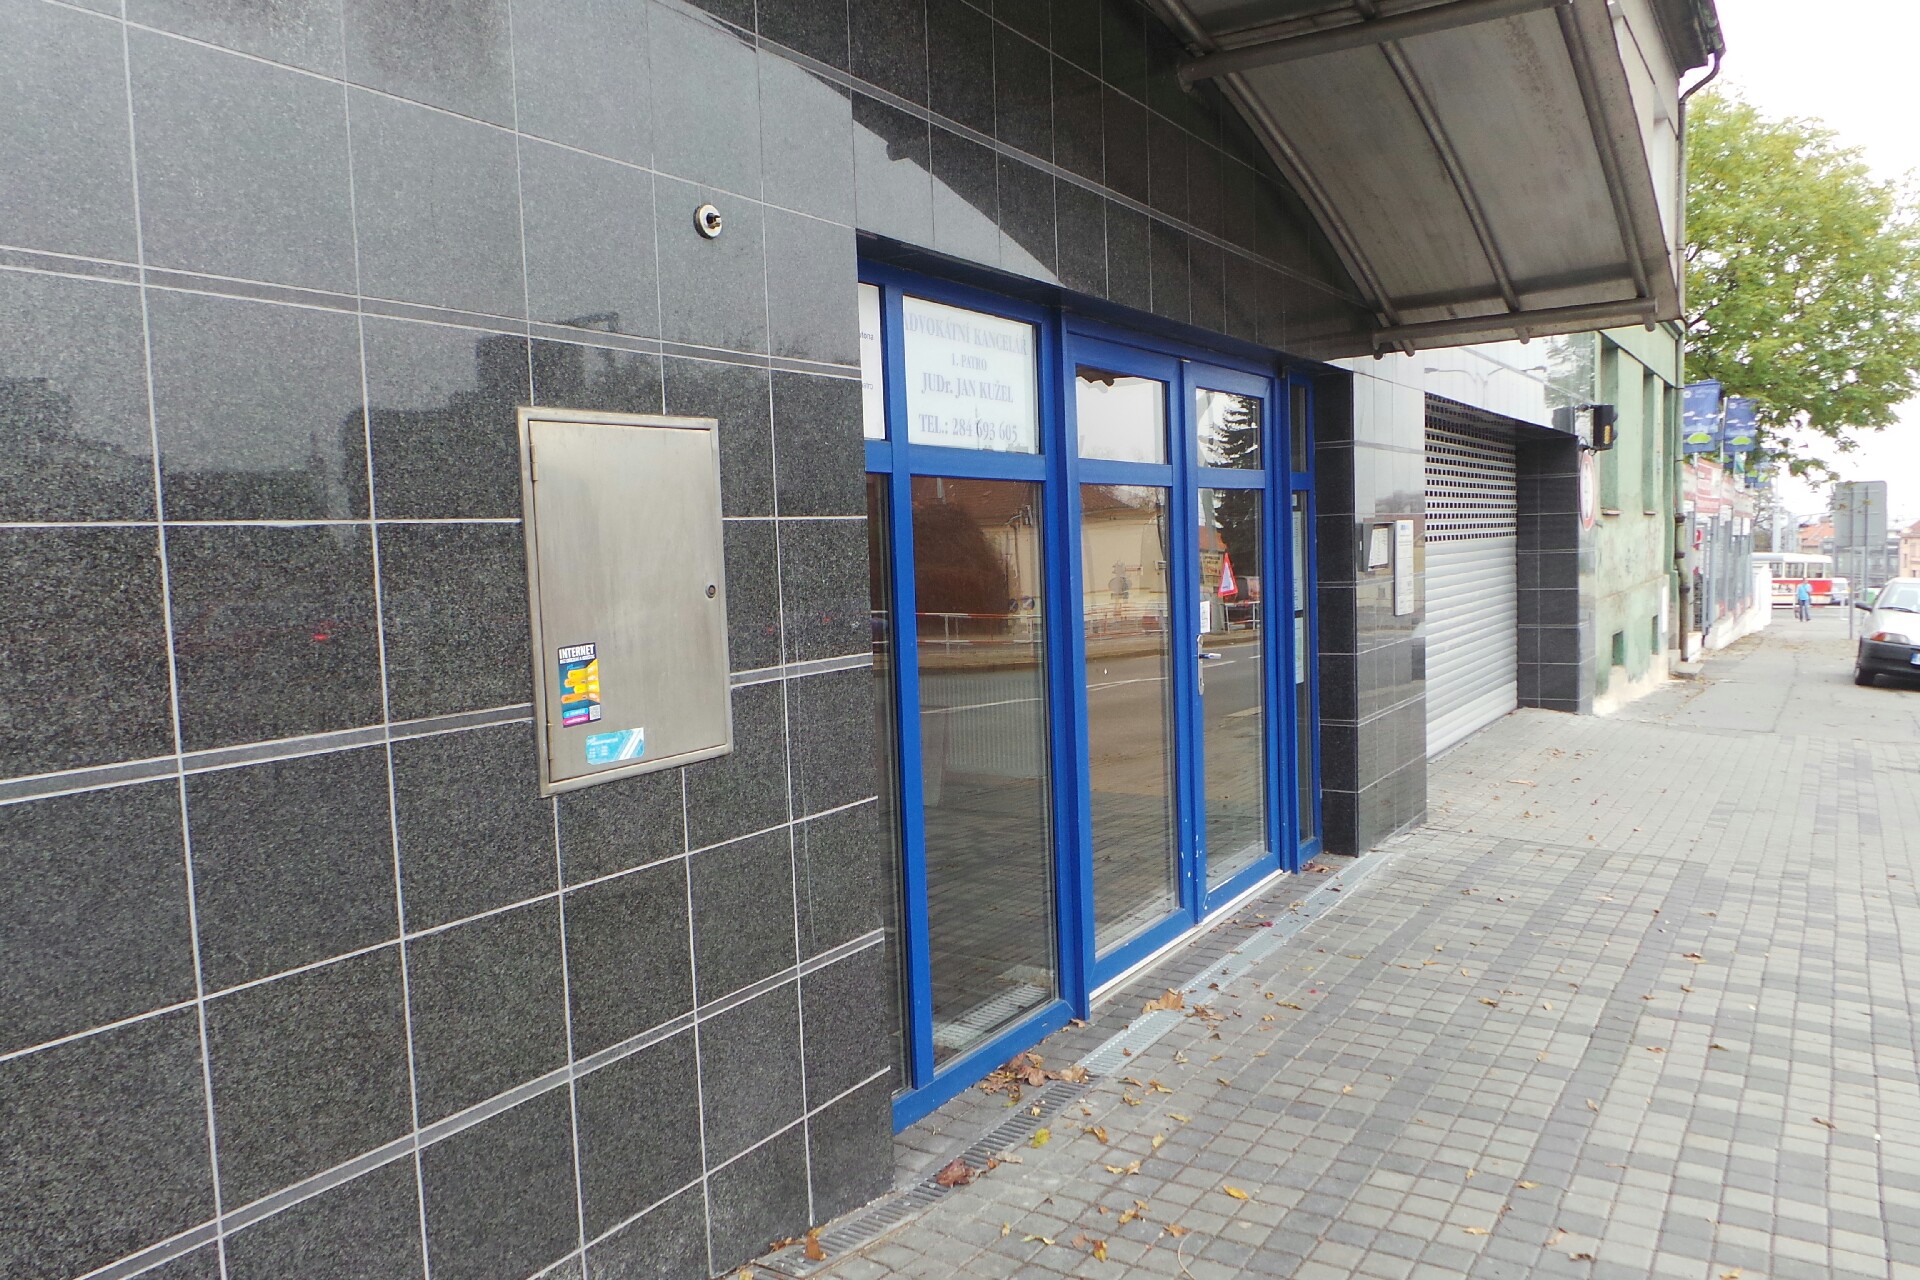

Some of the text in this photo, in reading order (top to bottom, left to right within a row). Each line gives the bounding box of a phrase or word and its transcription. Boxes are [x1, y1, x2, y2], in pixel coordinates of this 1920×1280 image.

[951, 353, 987, 371] 1. PATRO
[921, 372, 1013, 403] JUDr. JAN KUŽEL
[919, 413, 1018, 444] TEL.: 284 693 605
[559, 644, 595, 660] INTERNET
